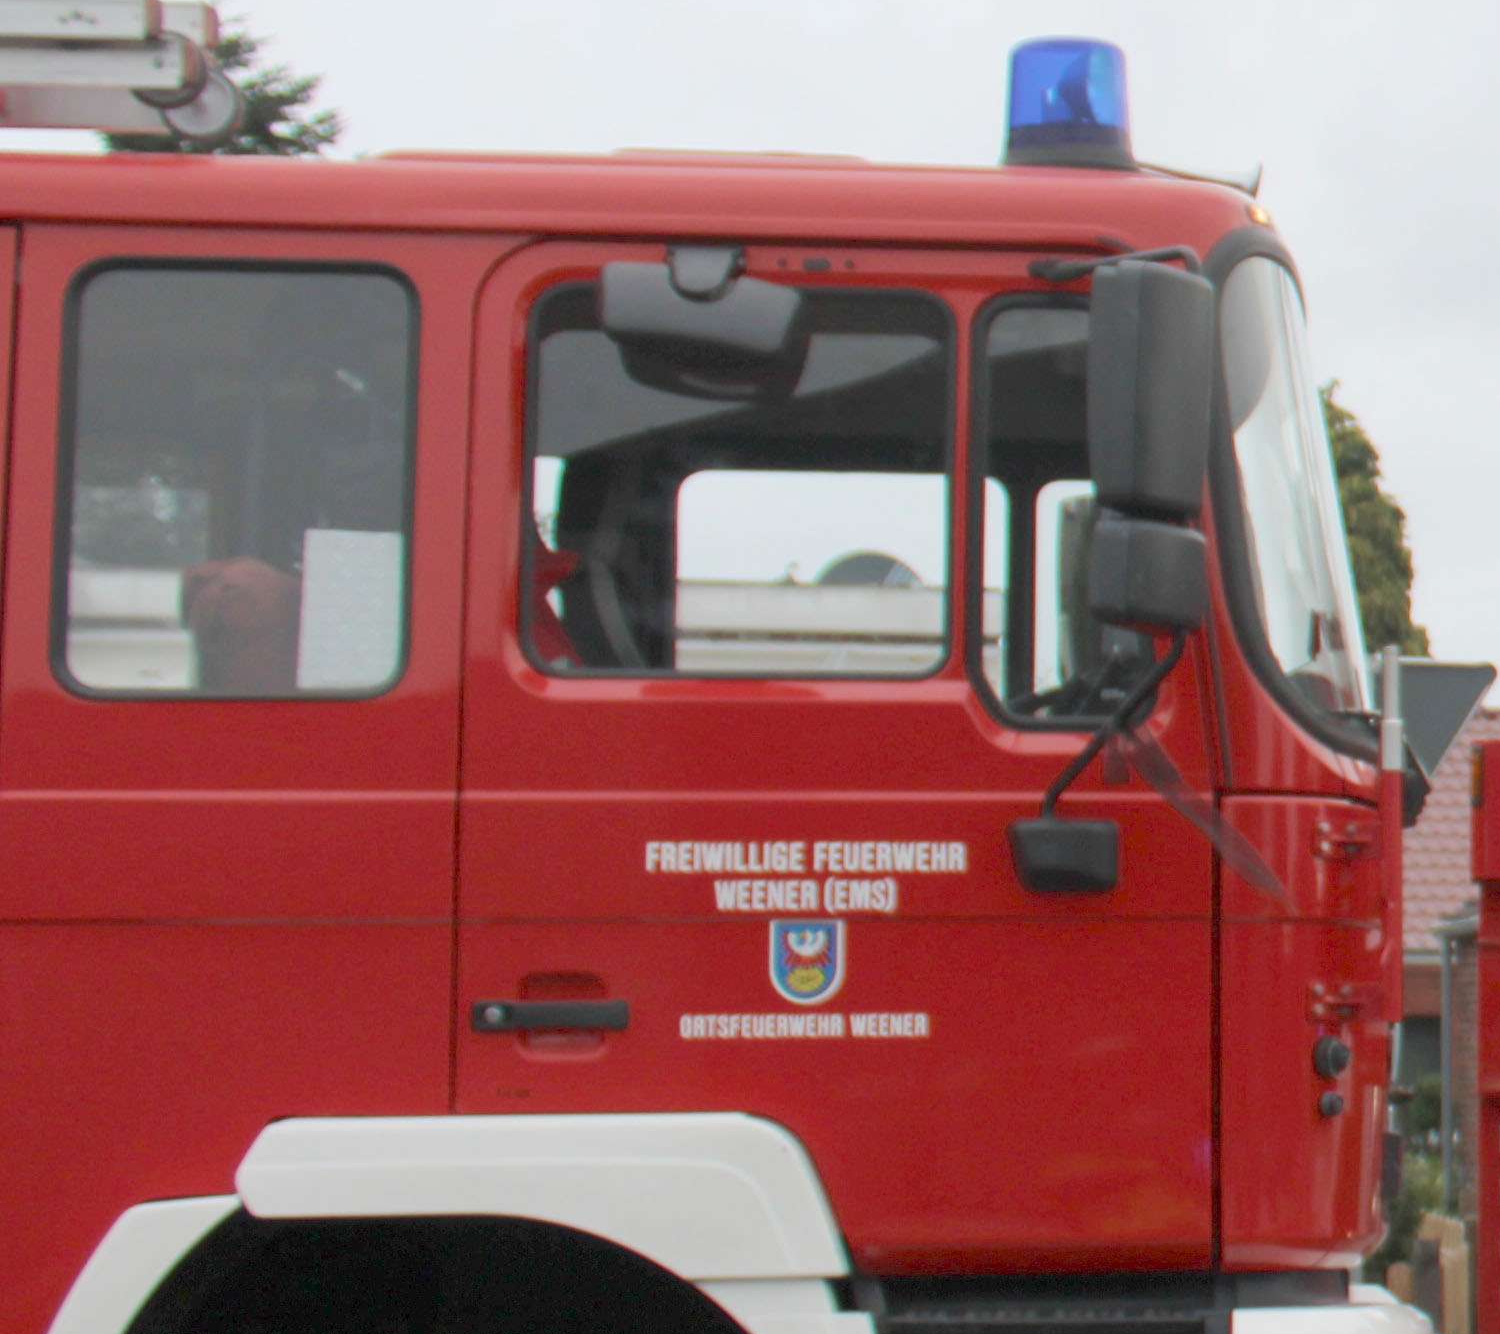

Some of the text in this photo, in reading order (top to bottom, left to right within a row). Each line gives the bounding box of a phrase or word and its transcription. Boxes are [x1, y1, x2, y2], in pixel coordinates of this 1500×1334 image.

[645, 841, 968, 873] FREIWILLIGE FEUERWEHR
[714, 877, 898, 913] WEENER (EMS)
[680, 1012, 930, 1038] ORTSFEUERWEHR WEENER
